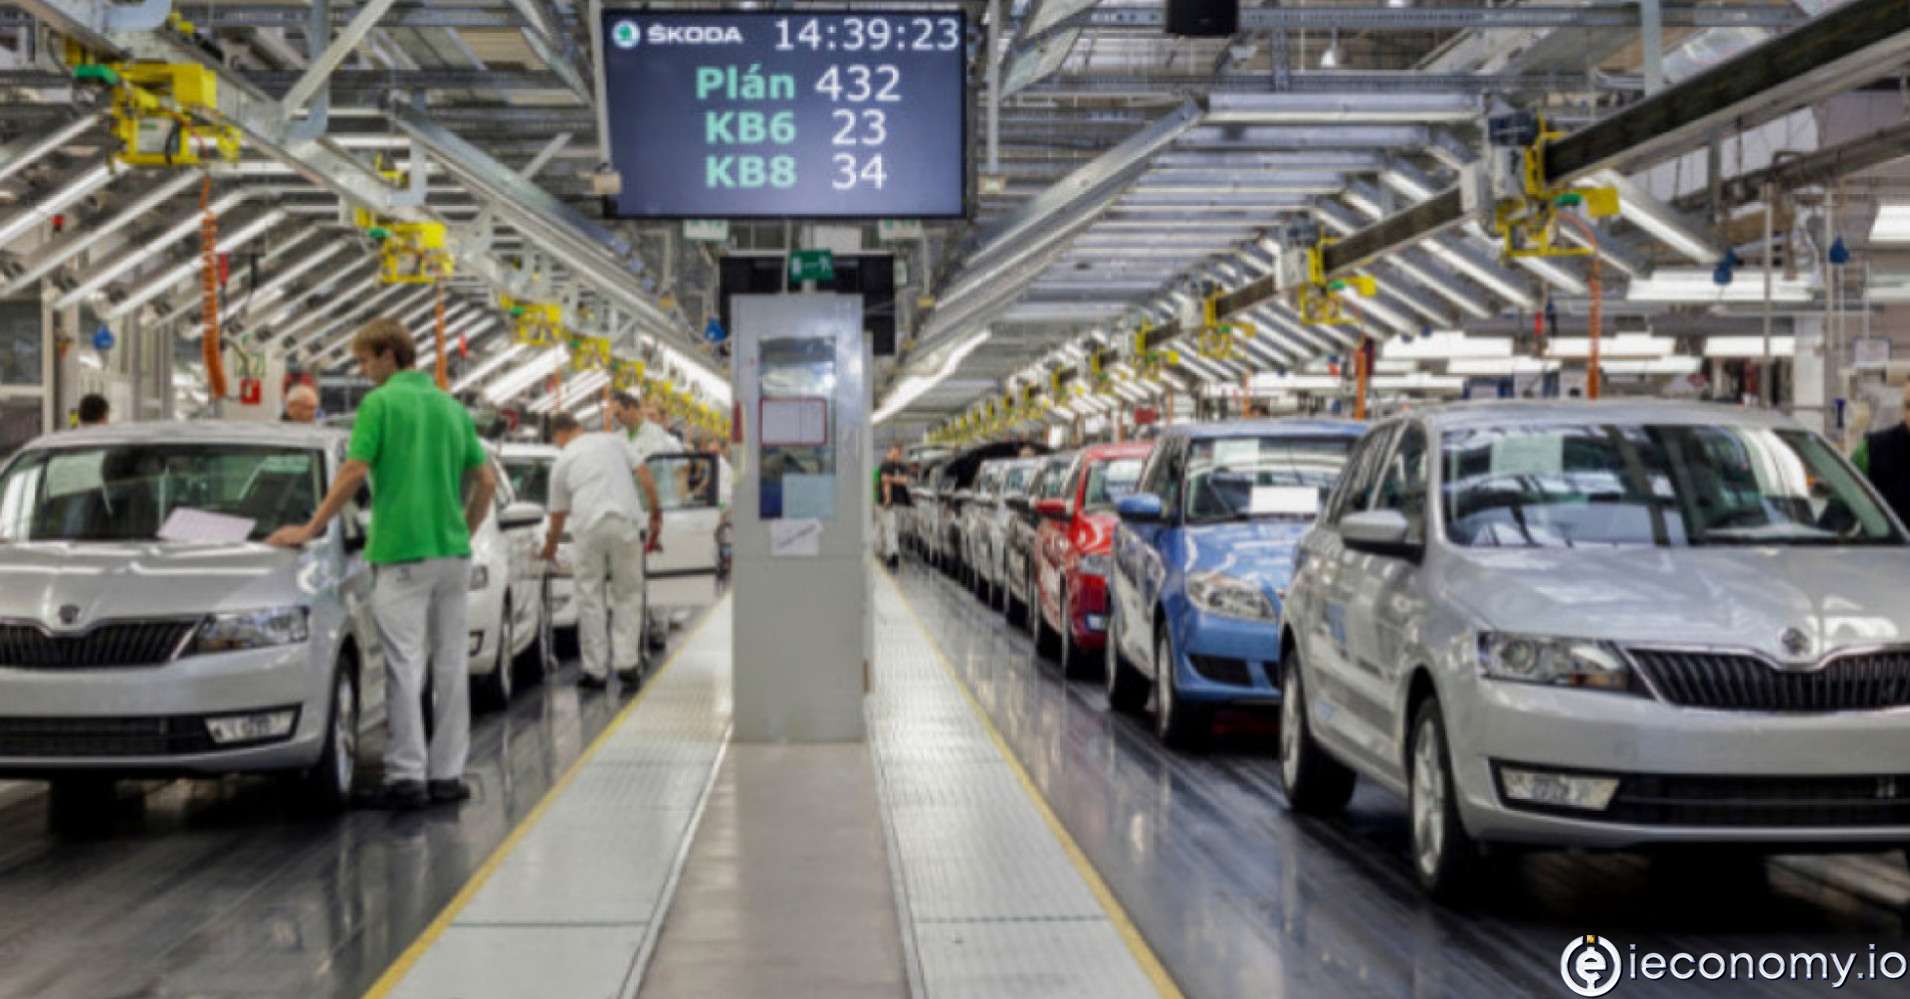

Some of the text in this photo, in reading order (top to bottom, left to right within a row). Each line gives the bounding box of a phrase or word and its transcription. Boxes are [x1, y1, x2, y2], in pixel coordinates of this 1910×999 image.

[647, 23, 743, 44] ŠKODA
[774, 18, 960, 51] 14:39:23
[696, 64, 902, 102] Plán 432
[705, 109, 887, 147] KB6 23
[705, 153, 887, 191] KB8 34
